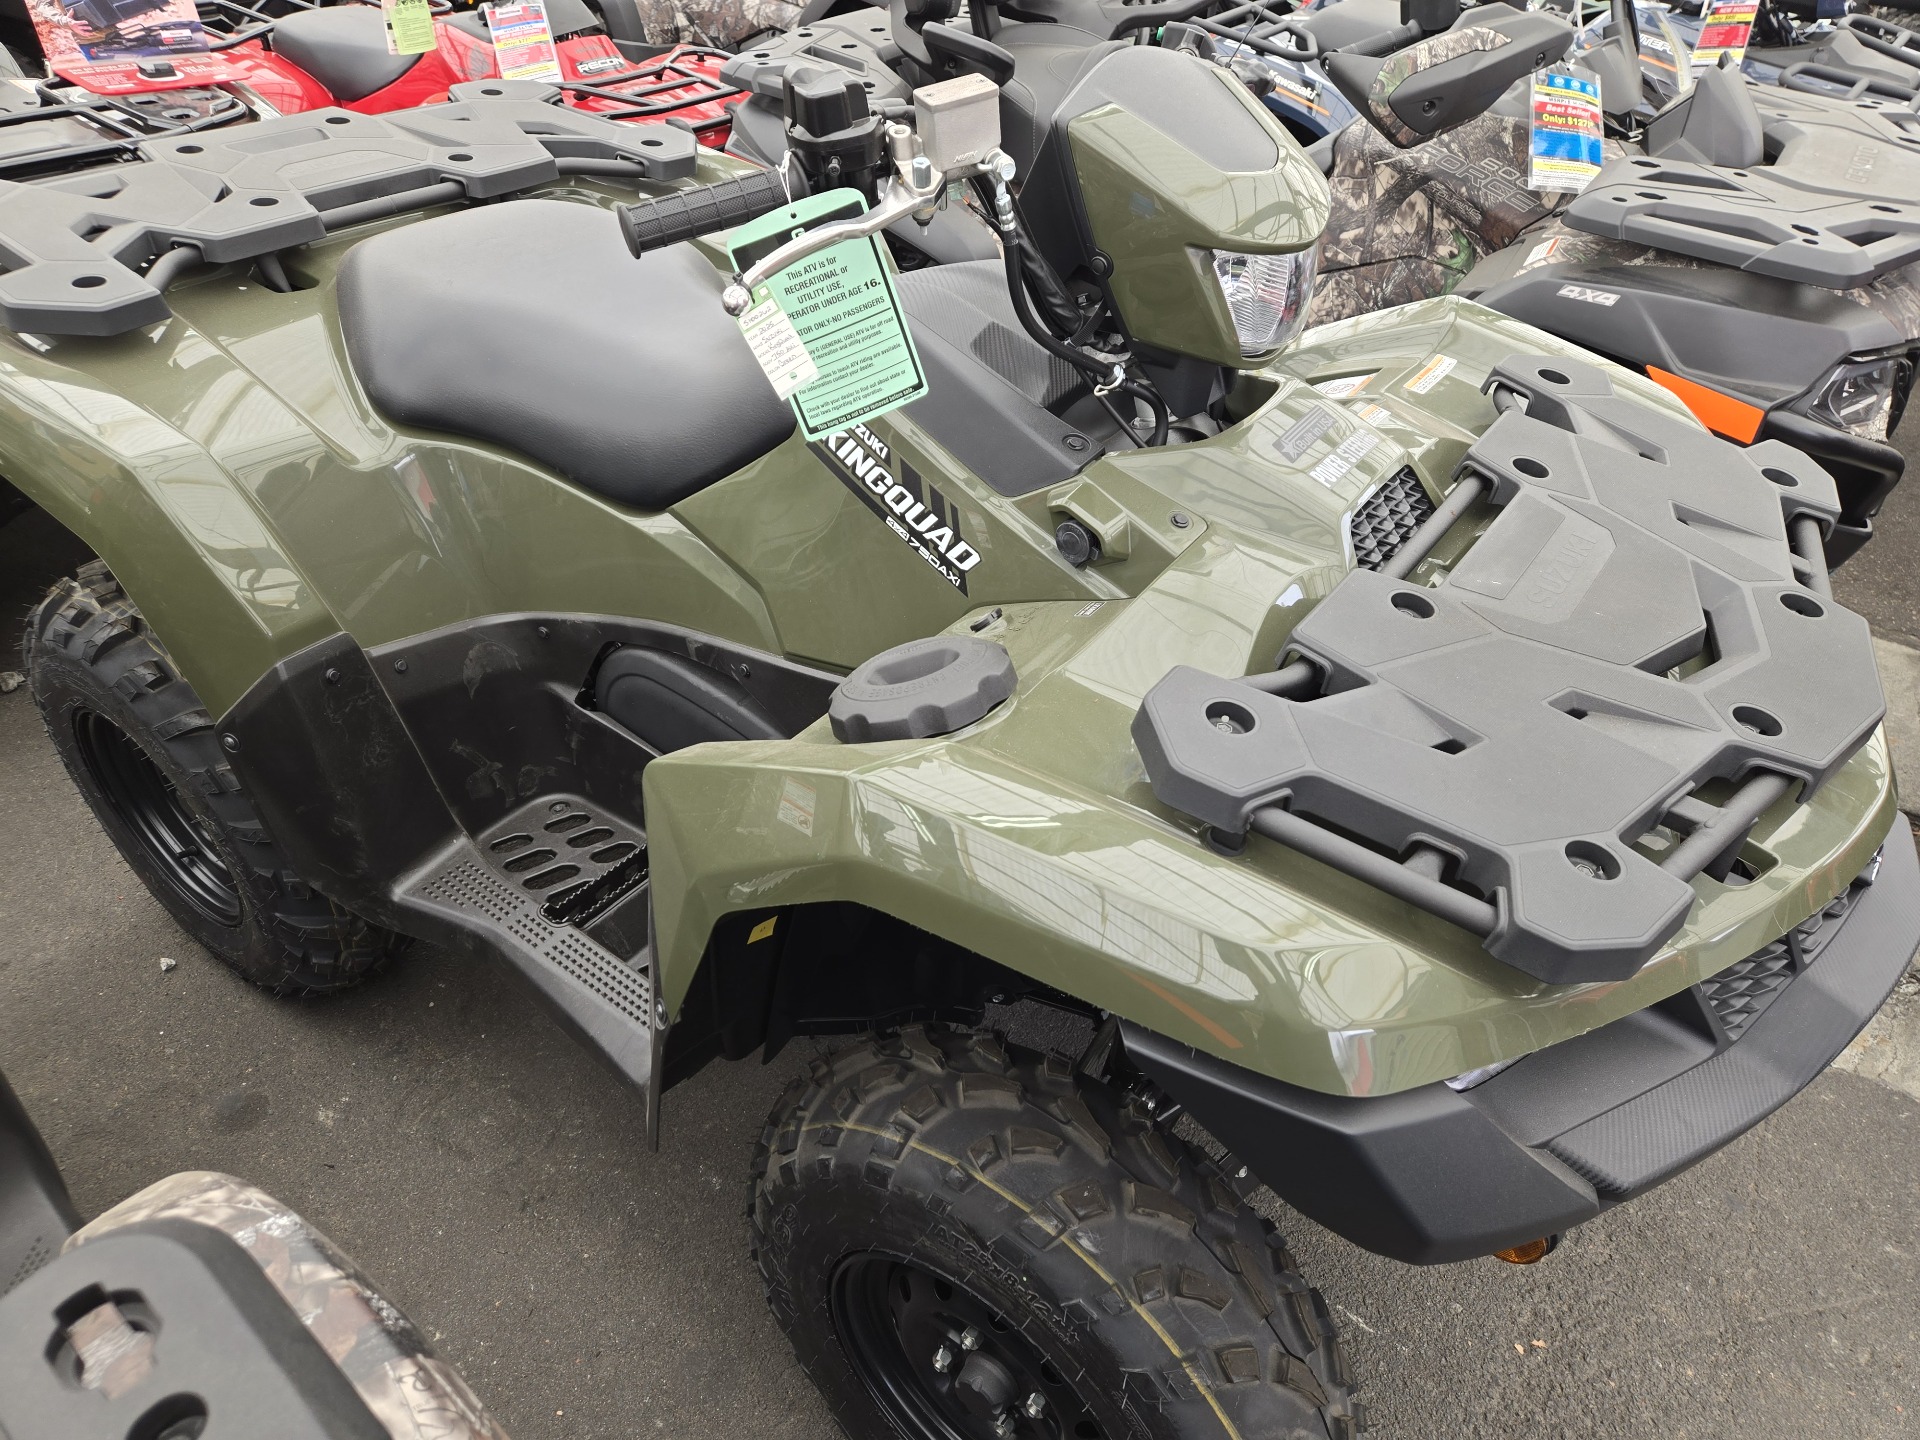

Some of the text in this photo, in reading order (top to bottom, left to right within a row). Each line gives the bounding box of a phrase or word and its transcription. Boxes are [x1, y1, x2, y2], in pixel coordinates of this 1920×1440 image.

[577, 58, 624, 73] RECON
[1268, 69, 1318, 100] Kawasaki
[1542, 113, 1565, 124] Only:
[1545, 104, 1591, 118] Best Seller!
[783, 265, 849, 296] RECREATIONAL or
[786, 254, 837, 281] This ATV is for
[796, 279, 845, 304] UTILITY USE,
[820, 291, 847, 308] UNDER
[846, 284, 863, 297] AGE
[862, 276, 881, 290] 16.
[813, 313, 842, 330] ONLY-NO
[841, 295, 885, 318] PASSENGERS
[815, 346, 839, 360] recreation
[847, 337, 861, 347] utility
[860, 329, 883, 342] purposes.
[819, 337, 843, 351] (GENERAL
[843, 332, 855, 341] USE)
[854, 328, 865, 336] ATV
[882, 315, 894, 324] road
[849, 360, 859, 368] ATV
[858, 354, 873, 364] riding
[879, 341, 902, 355] available.
[805, 404, 820, 414] Check
[819, 400, 830, 408] with
[830, 396, 840, 405] your
[839, 390, 854, 400] dealer
[859, 384, 869, 392] find
[876, 375, 889, 385] about
[889, 371, 900, 379] state
[806, 377, 832, 392] information
[831, 371, 849, 382] contact
[848, 367, 859, 376] your
[858, 361, 875, 371] dealer.
[808, 386, 884, 419] local laws regarding ATV operation.
[816, 422, 827, 430] This
[826, 418, 839, 427] hang
[838, 415, 846, 423] tag
[869, 397, 889, 409] removed
[888, 391, 903, 401] before
[902, 386, 914, 395] sale.
[852, 423, 889, 459] ZUKI
[1297, 414, 1334, 450] Built in USA
[1309, 428, 1379, 487] POWER STEERING
[824, 430, 982, 571] KINGQUAD
[1527, 533, 1597, 608] SUZUKI
